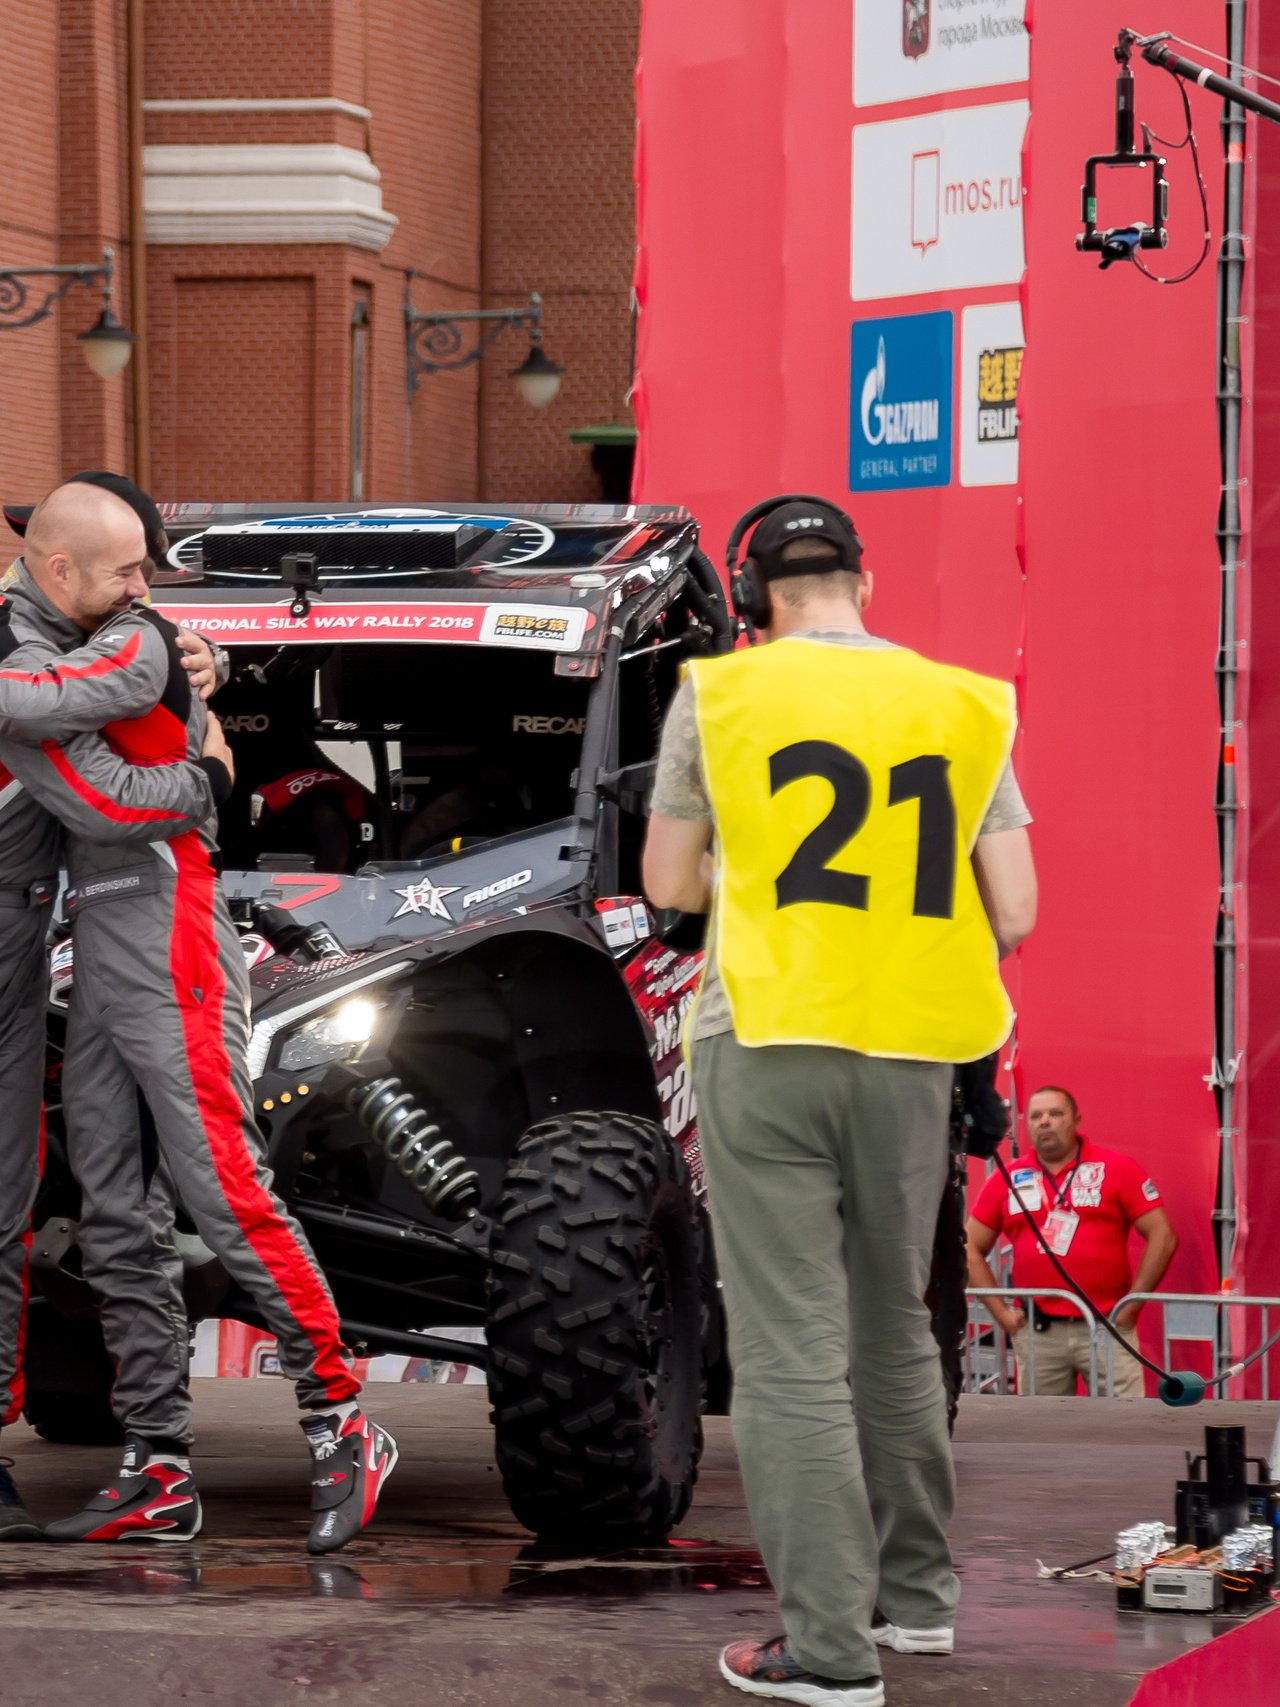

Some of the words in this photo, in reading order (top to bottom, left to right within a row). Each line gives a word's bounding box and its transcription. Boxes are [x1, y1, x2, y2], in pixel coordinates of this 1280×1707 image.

[944, 176, 1022, 214] mos.ru
[885, 399, 939, 445] GAZPROM
[860, 458, 900, 480] GENERAL
[902, 453, 938, 475] PARTNER
[179, 617, 265, 631] ATIONAL
[266, 616, 309, 629] SILK
[314, 616, 360, 628] WAY
[362, 616, 426, 628] RALLY
[428, 616, 475, 629] 2018
[494, 627, 565, 641] FBLIFE.COM
[768, 739, 958, 920] 21
[463, 869, 533, 909] RIGID
